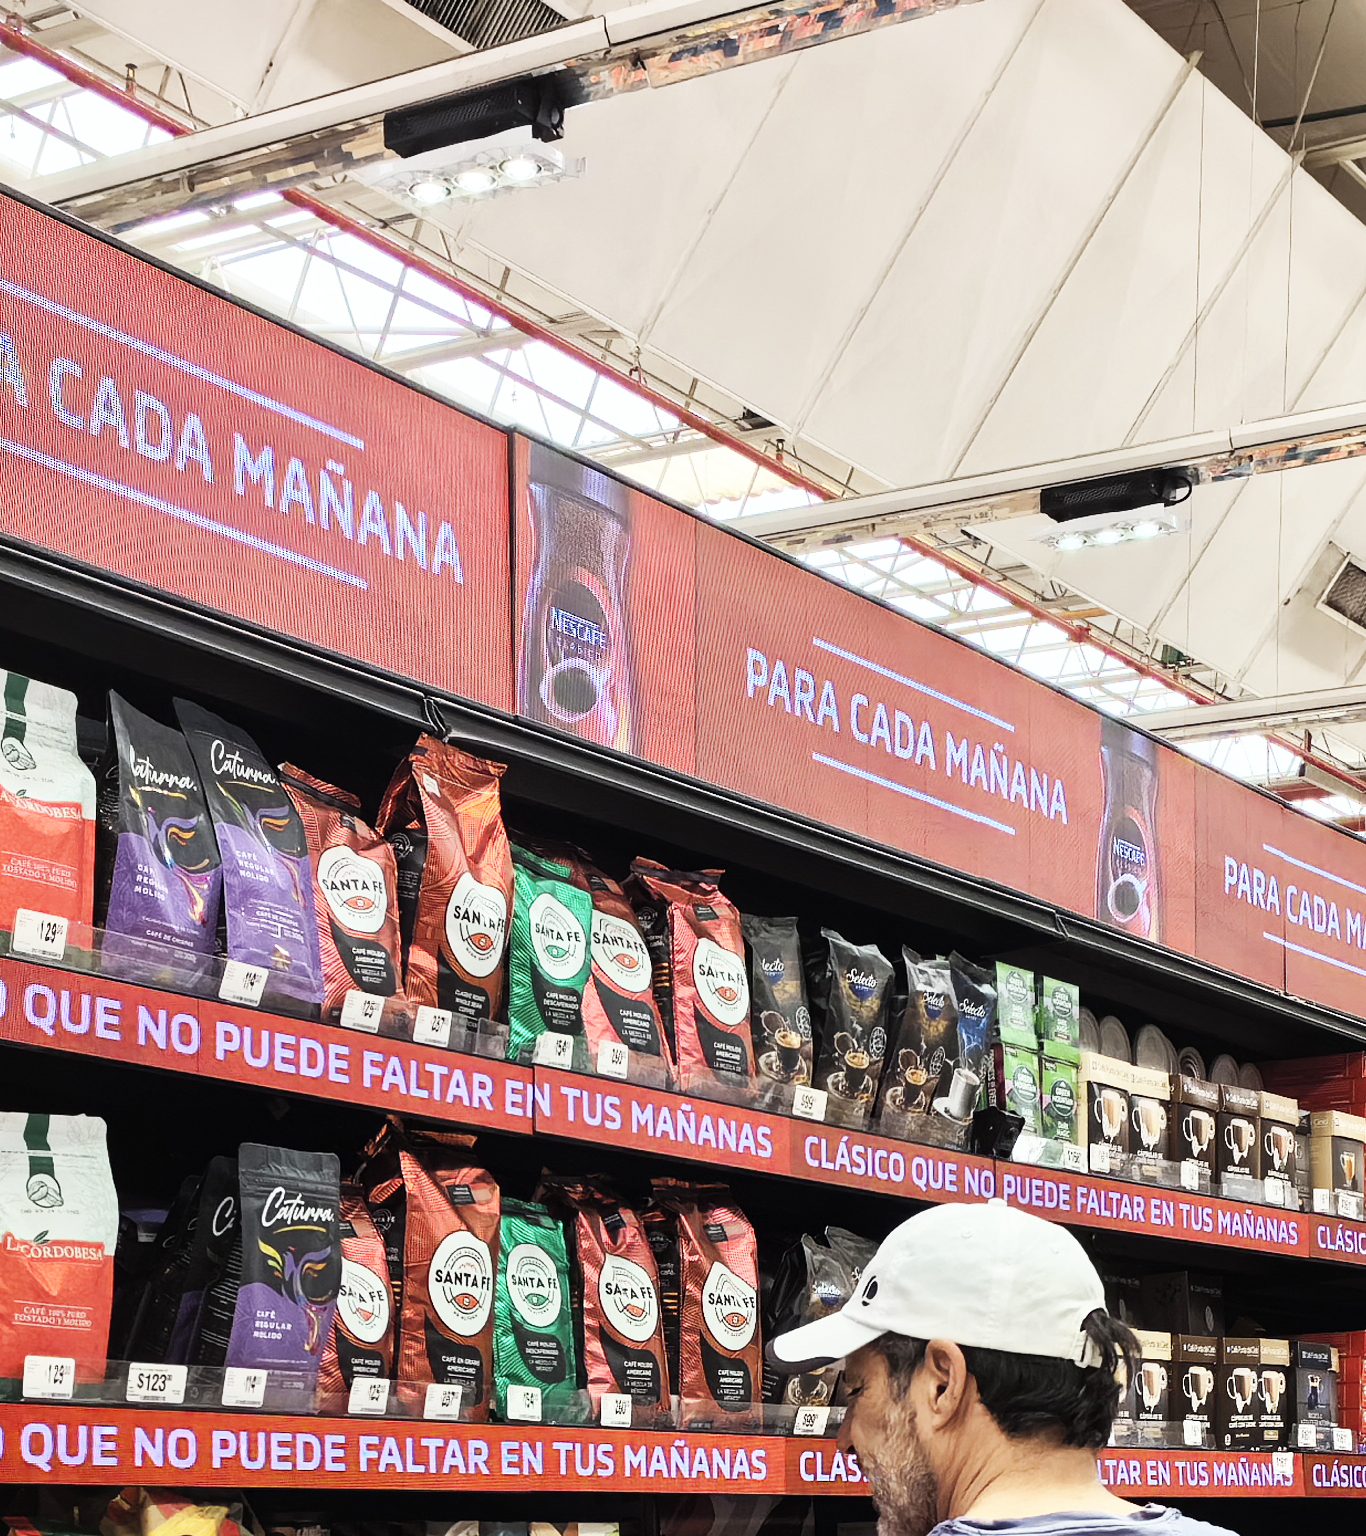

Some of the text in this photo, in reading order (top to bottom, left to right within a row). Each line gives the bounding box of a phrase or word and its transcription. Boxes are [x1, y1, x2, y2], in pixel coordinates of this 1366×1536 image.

[49, 358, 214, 482] CADA
[235, 432, 464, 582] MAÑANA
[746, 648, 1069, 825] PARA CADA MAÑANA
[1224, 855, 1280, 916] PARA
[1286, 885, 1341, 937] CADA
[23, 983, 121, 1036] QUE
[137, 1006, 201, 1057] NO
[215, 1027, 352, 1085] PUEDE
[362, 1050, 494, 1110] FALTAR
[505, 1077, 553, 1118] EN
[560, 1096, 622, 1131] TUS
[630, 1103, 773, 1158] MAÑANAS
[261, 1185, 335, 1226] Caturra
[804, 1134, 1298, 1245] CLÁSICO QUE NO PUEDE FALTAR EN TUS MAÑANAS
[20, 1424, 118, 1472] QUE
[133, 1427, 197, 1469] NO
[211, 1432, 346, 1472] PUEDE
[360, 1435, 488, 1475] FALTAR
[501, 1441, 545, 1475] EN
[552, 1442, 612, 1476] TUS
[623, 1436, 768, 1481] MAÑANAS
